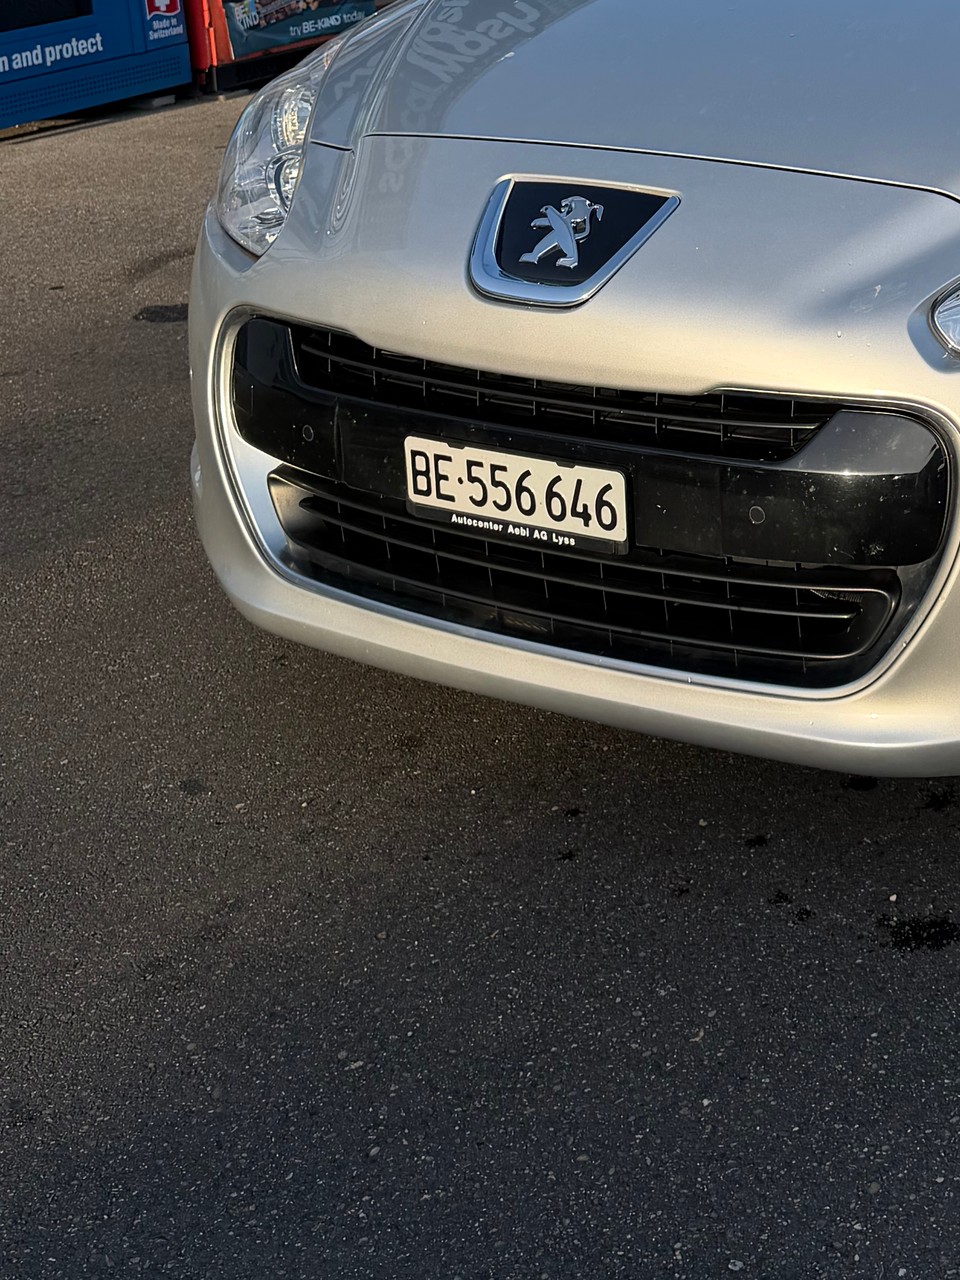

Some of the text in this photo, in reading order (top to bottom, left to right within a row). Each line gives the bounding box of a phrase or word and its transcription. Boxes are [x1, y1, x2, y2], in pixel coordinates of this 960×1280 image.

[152, 17, 177, 30] Made in
[289, 25, 302, 36] try
[149, 24, 184, 41] Switzerland
[11, 44, 43, 70] and
[44, 32, 103, 67] protect
[451, 513, 576, 546] Autocenter Aebi AG Lyss
